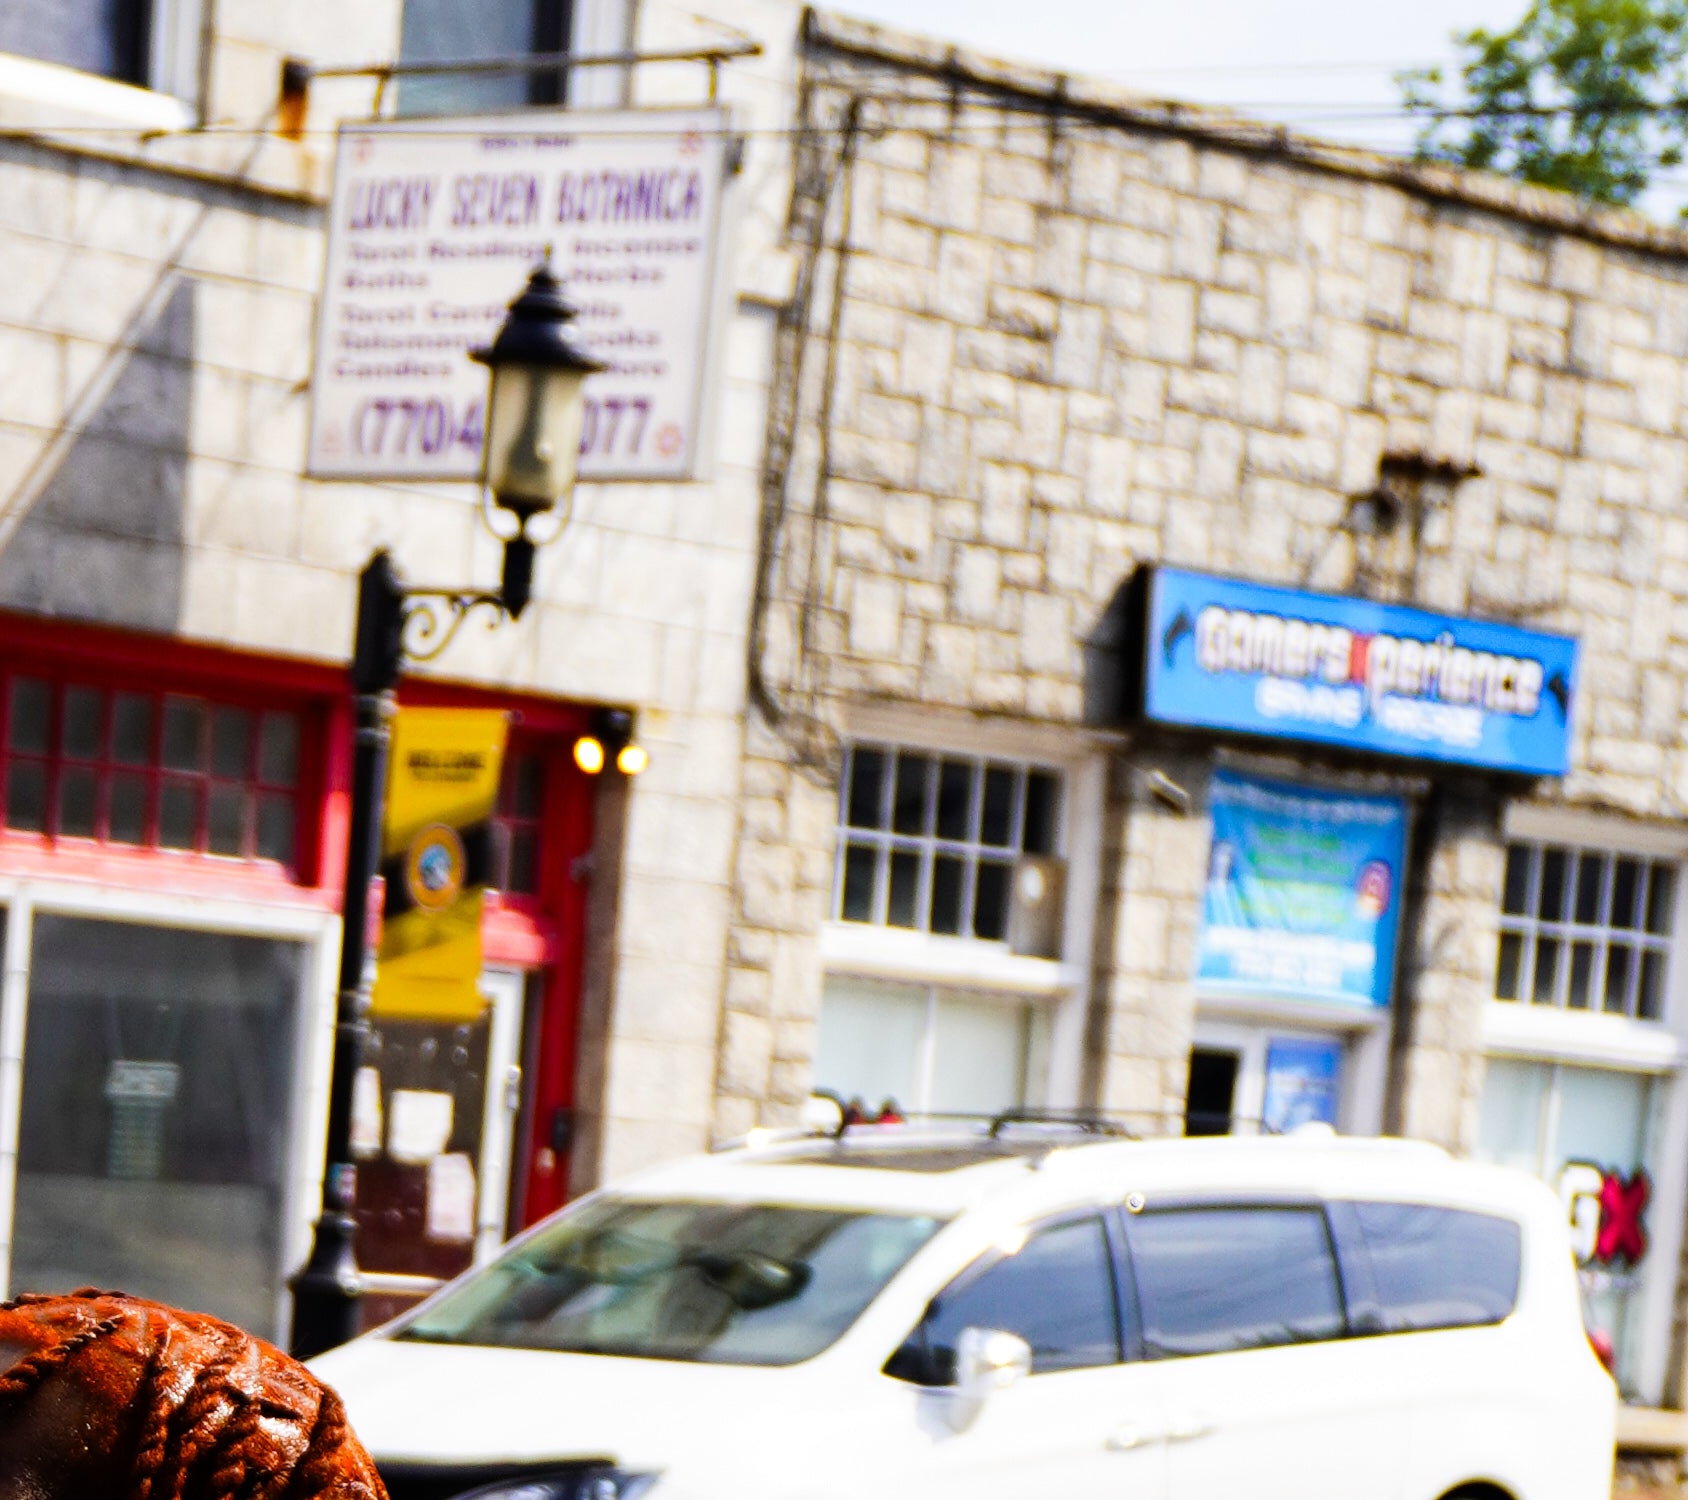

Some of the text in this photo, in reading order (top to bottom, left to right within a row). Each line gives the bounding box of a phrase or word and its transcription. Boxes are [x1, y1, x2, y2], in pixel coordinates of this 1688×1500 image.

[348, 166, 700, 230] LUCKY SEVEN BOTANICA
